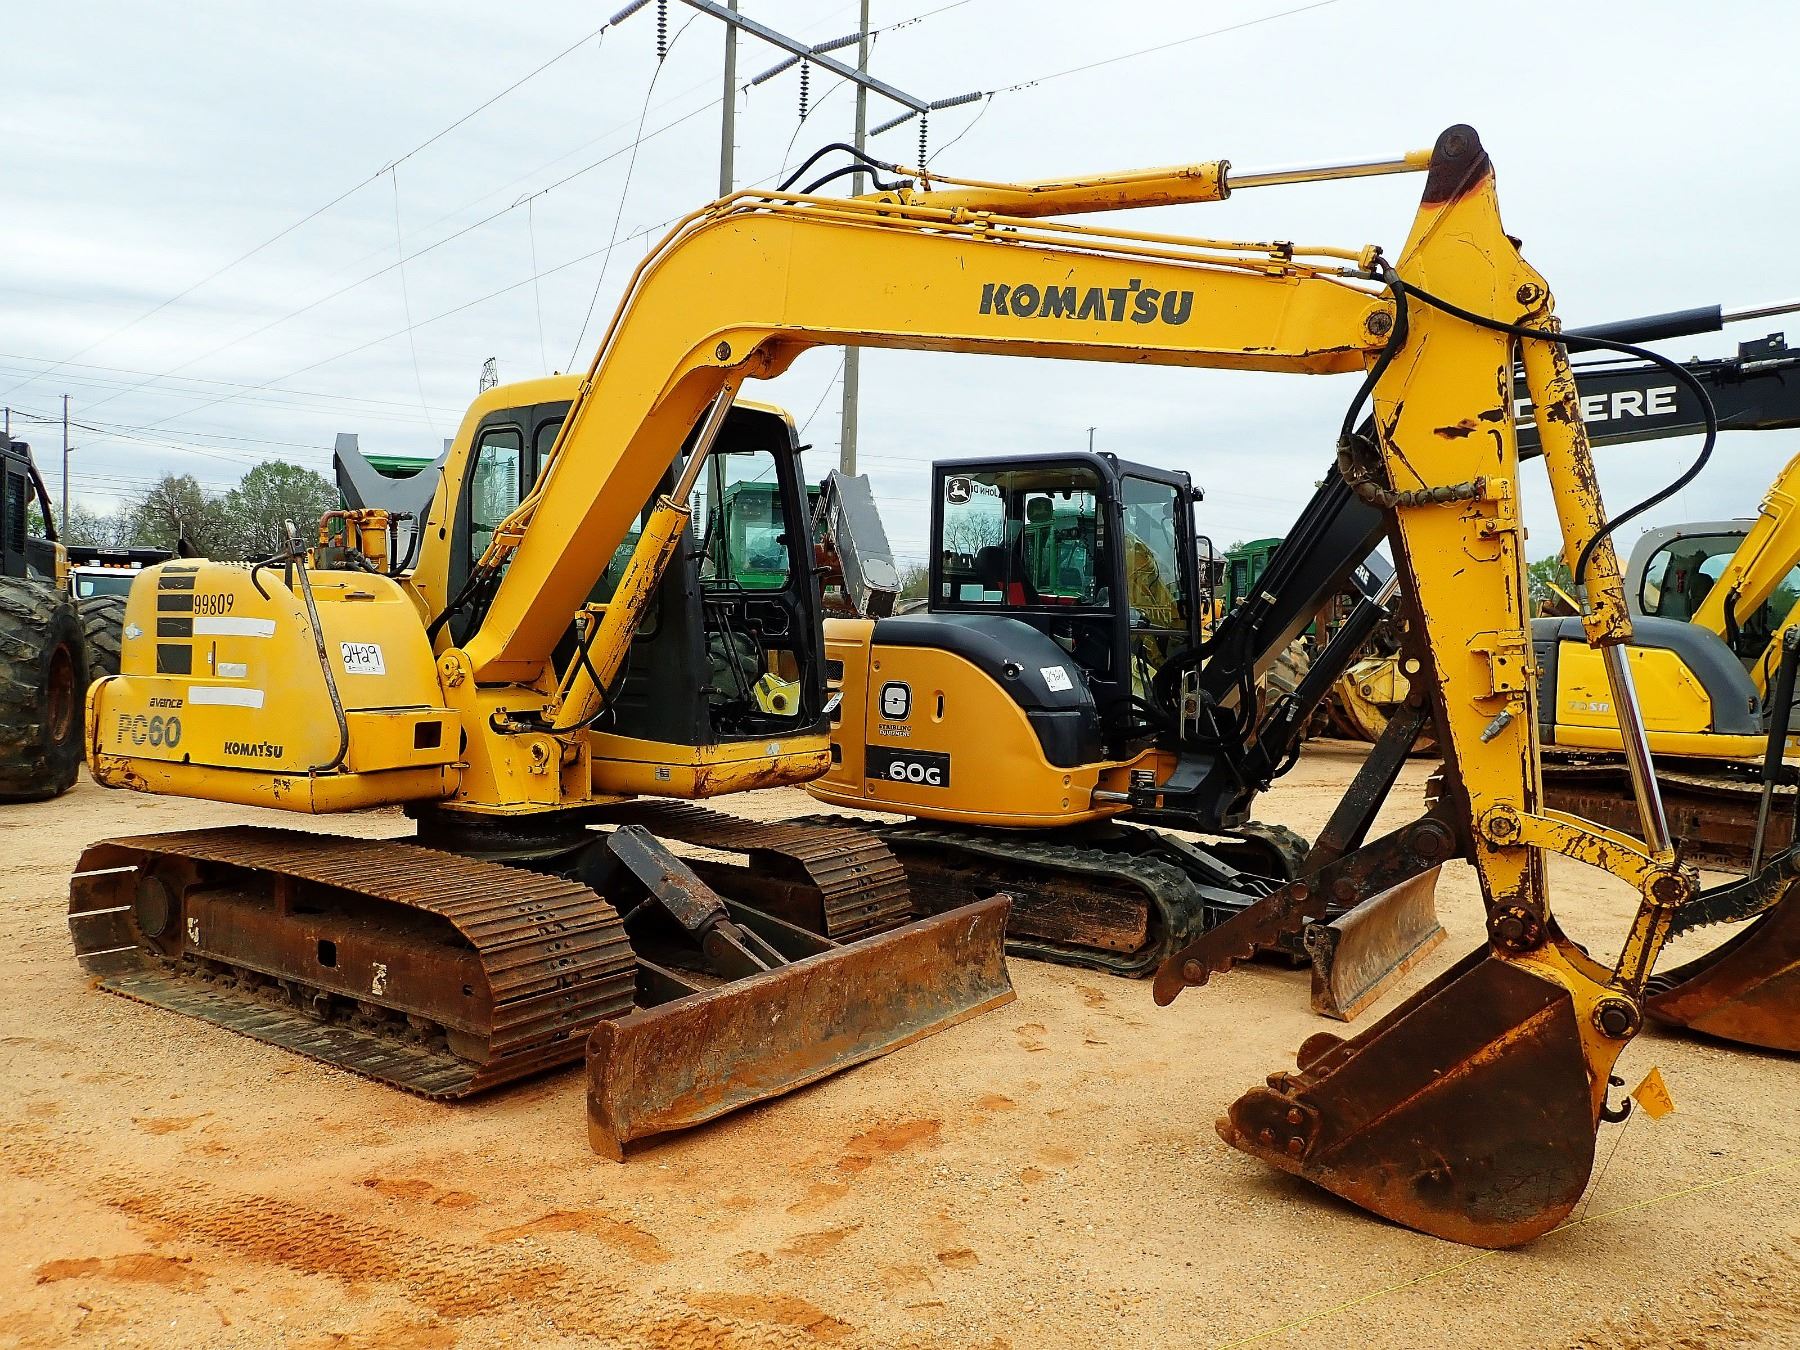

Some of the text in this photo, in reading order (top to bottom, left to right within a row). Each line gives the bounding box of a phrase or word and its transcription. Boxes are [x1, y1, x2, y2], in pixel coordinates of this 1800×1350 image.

[979, 278, 1194, 325] KOMATSU
[194, 593, 234, 615] 99809
[343, 643, 380, 666] 2429
[149, 697, 183, 708] avance
[117, 713, 181, 748] PC60
[224, 741, 283, 759] KOMATSU
[889, 761, 941, 785] 60G
